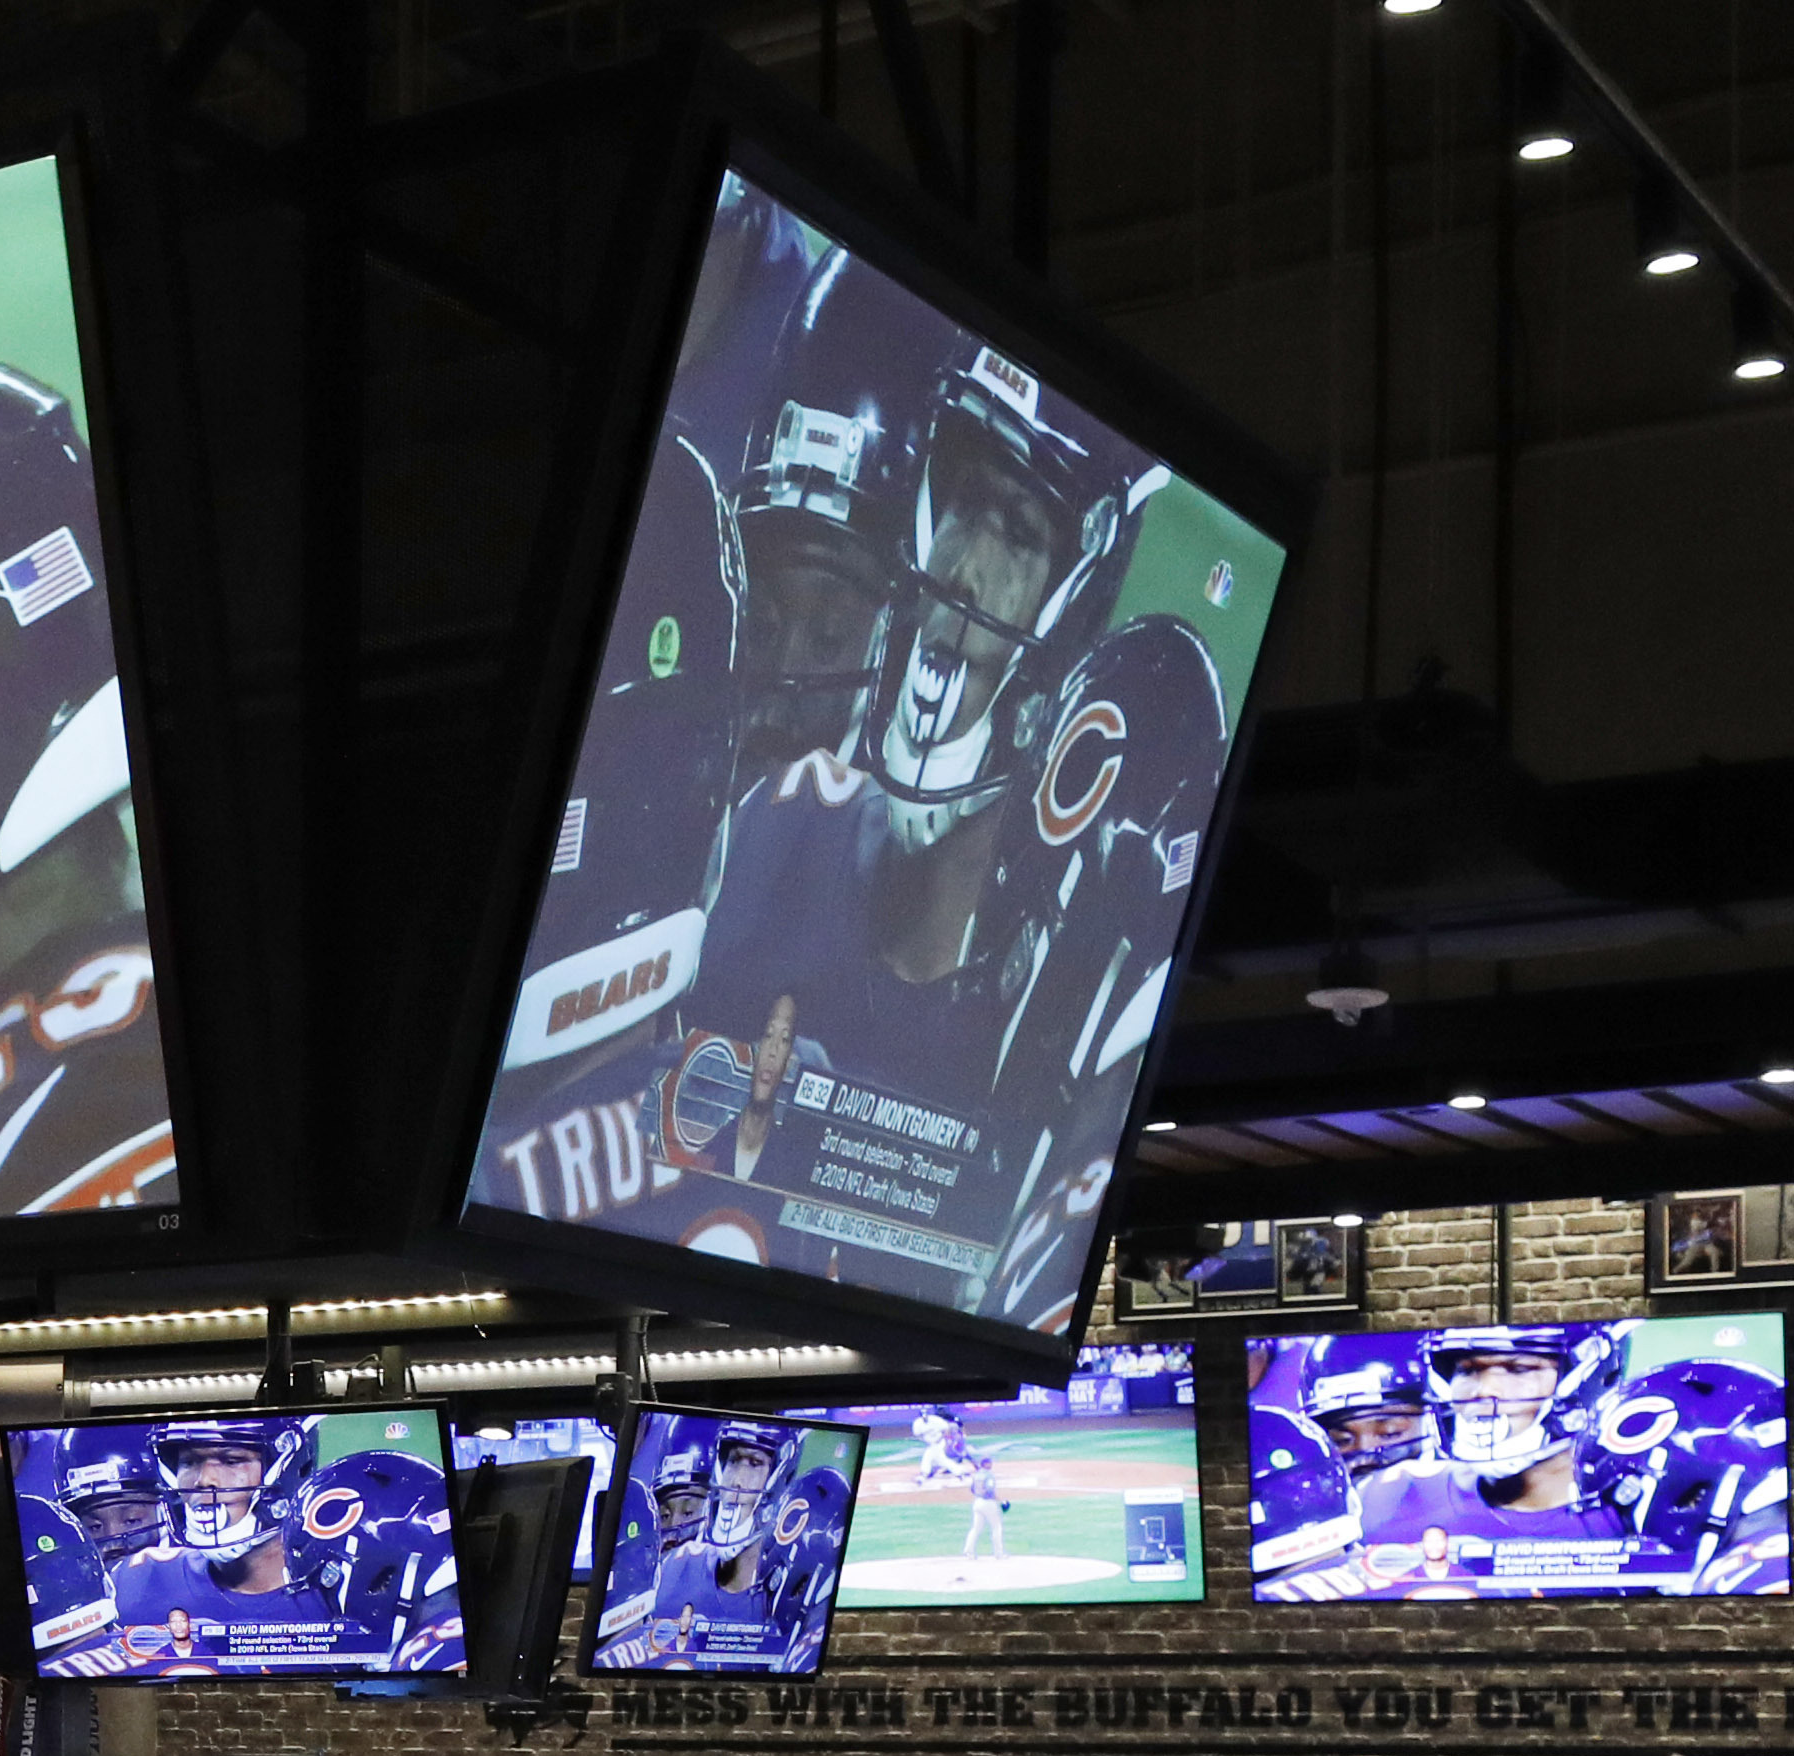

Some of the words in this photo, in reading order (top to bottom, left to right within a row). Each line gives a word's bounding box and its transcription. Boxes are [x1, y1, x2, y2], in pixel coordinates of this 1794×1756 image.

[547, 949, 674, 1037] BEARS
[833, 1084, 876, 1123] DAVID
[871, 1096, 967, 1150] MONTGOMERY
[229, 1624, 258, 1635] DAVID
[260, 1623, 330, 1634] MONTGOMERY
[21, 1695, 38, 1746] LIGHT
[612, 1686, 748, 1725] MESS
[766, 1685, 907, 1727] WITH
[922, 1684, 1035, 1727] THE
[1054, 1684, 1312, 1728] BUFFALO
[1334, 1686, 1453, 1728] YOU
[1475, 1685, 1599, 1728] GET
[1623, 1684, 1760, 1729] THE
